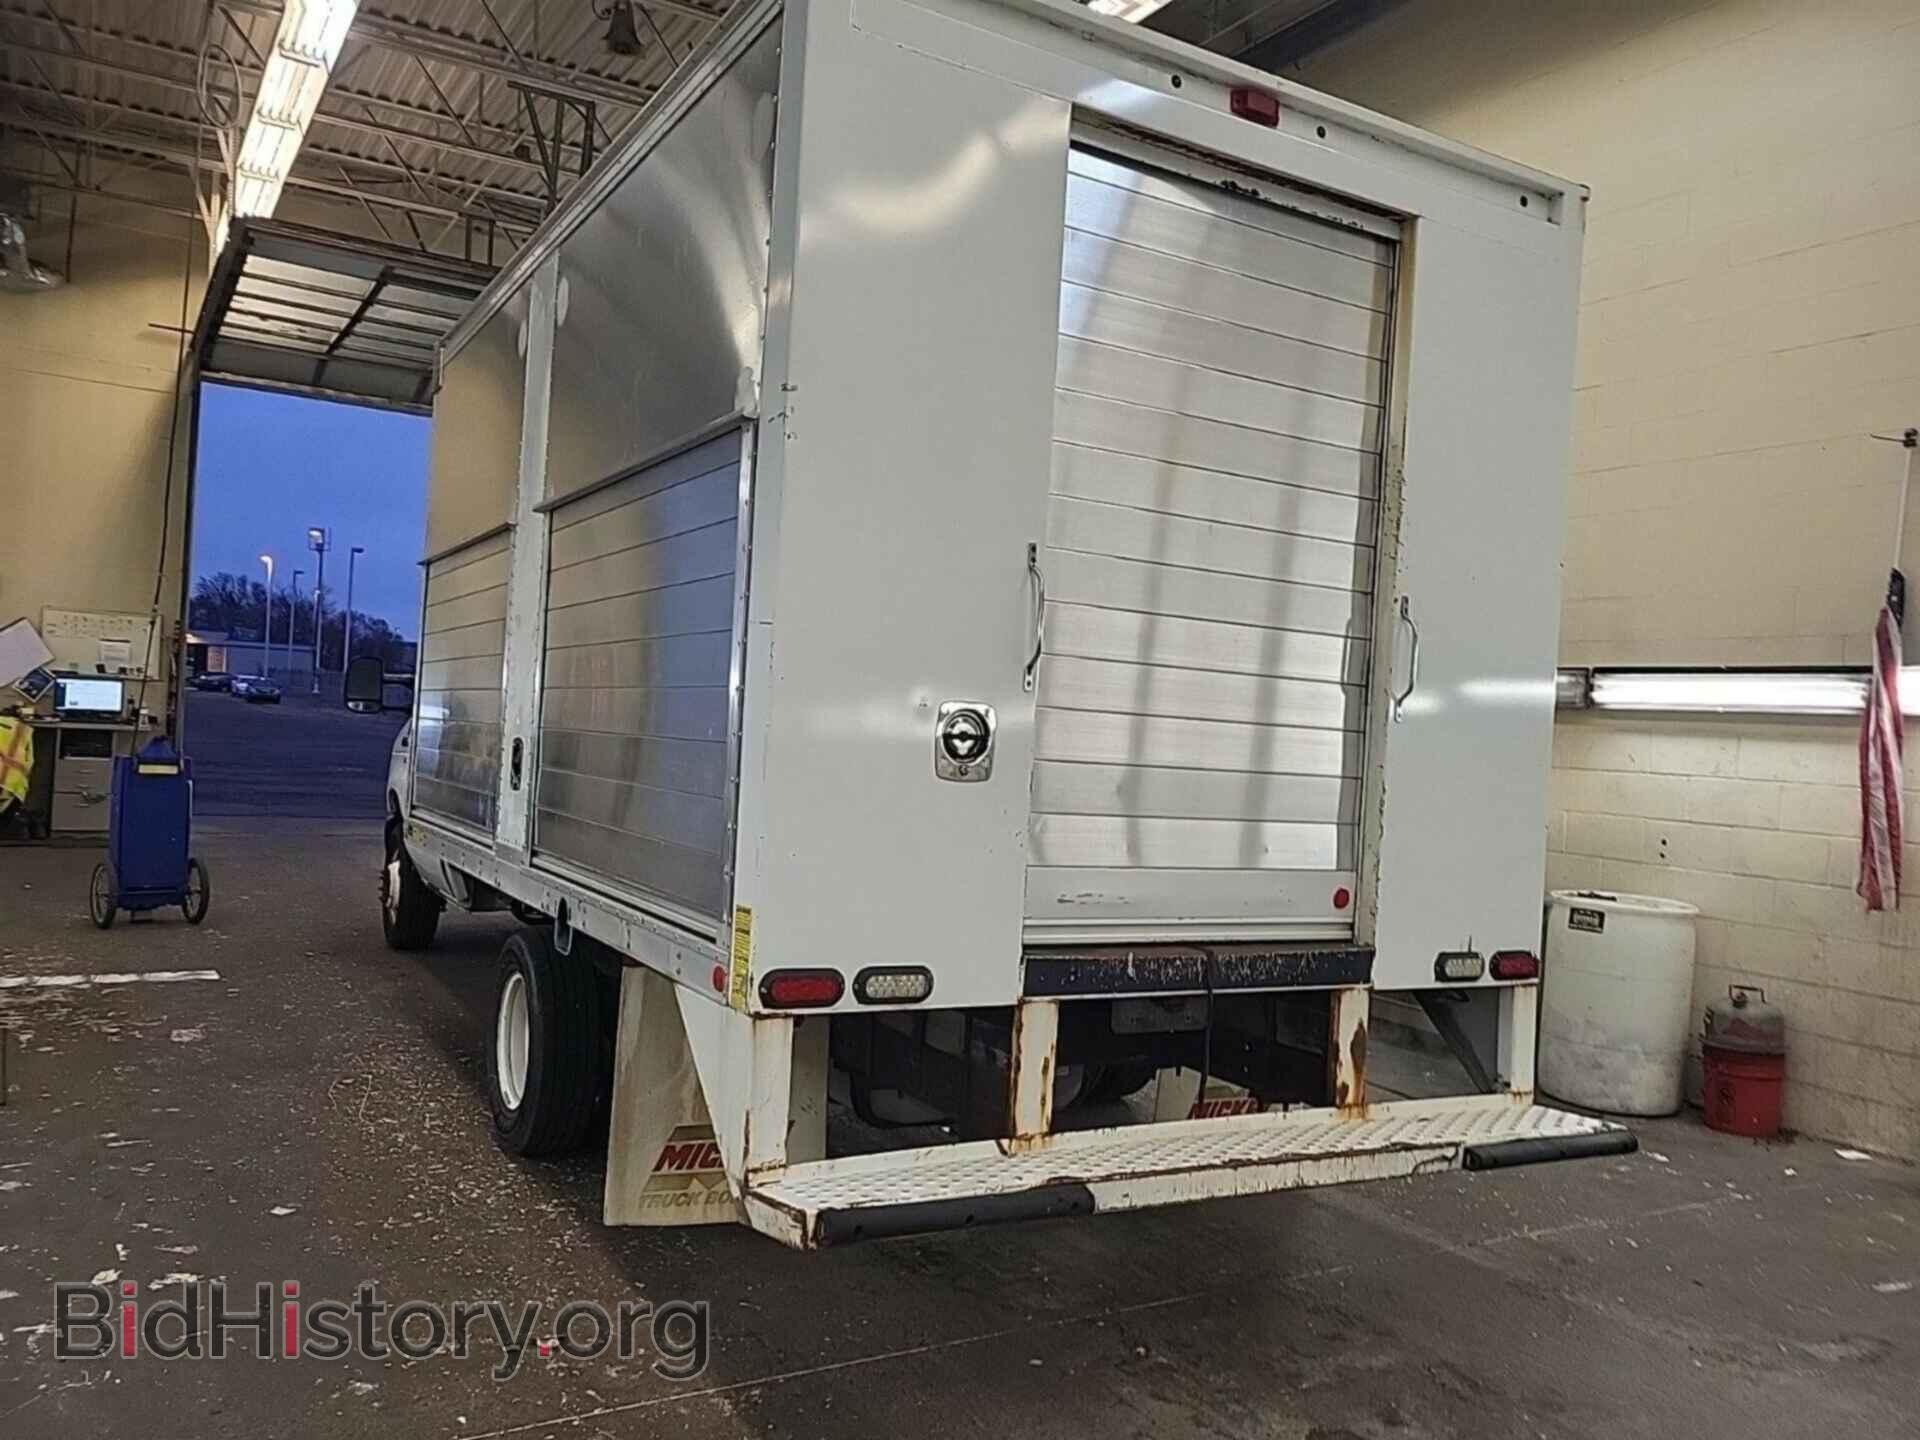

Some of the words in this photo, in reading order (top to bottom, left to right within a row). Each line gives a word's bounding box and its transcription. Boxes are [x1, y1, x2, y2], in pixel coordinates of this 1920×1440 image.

[652, 1142, 724, 1172] MIC
[639, 1191, 702, 1209] TRUCK
[704, 1190, 733, 1206] BO
